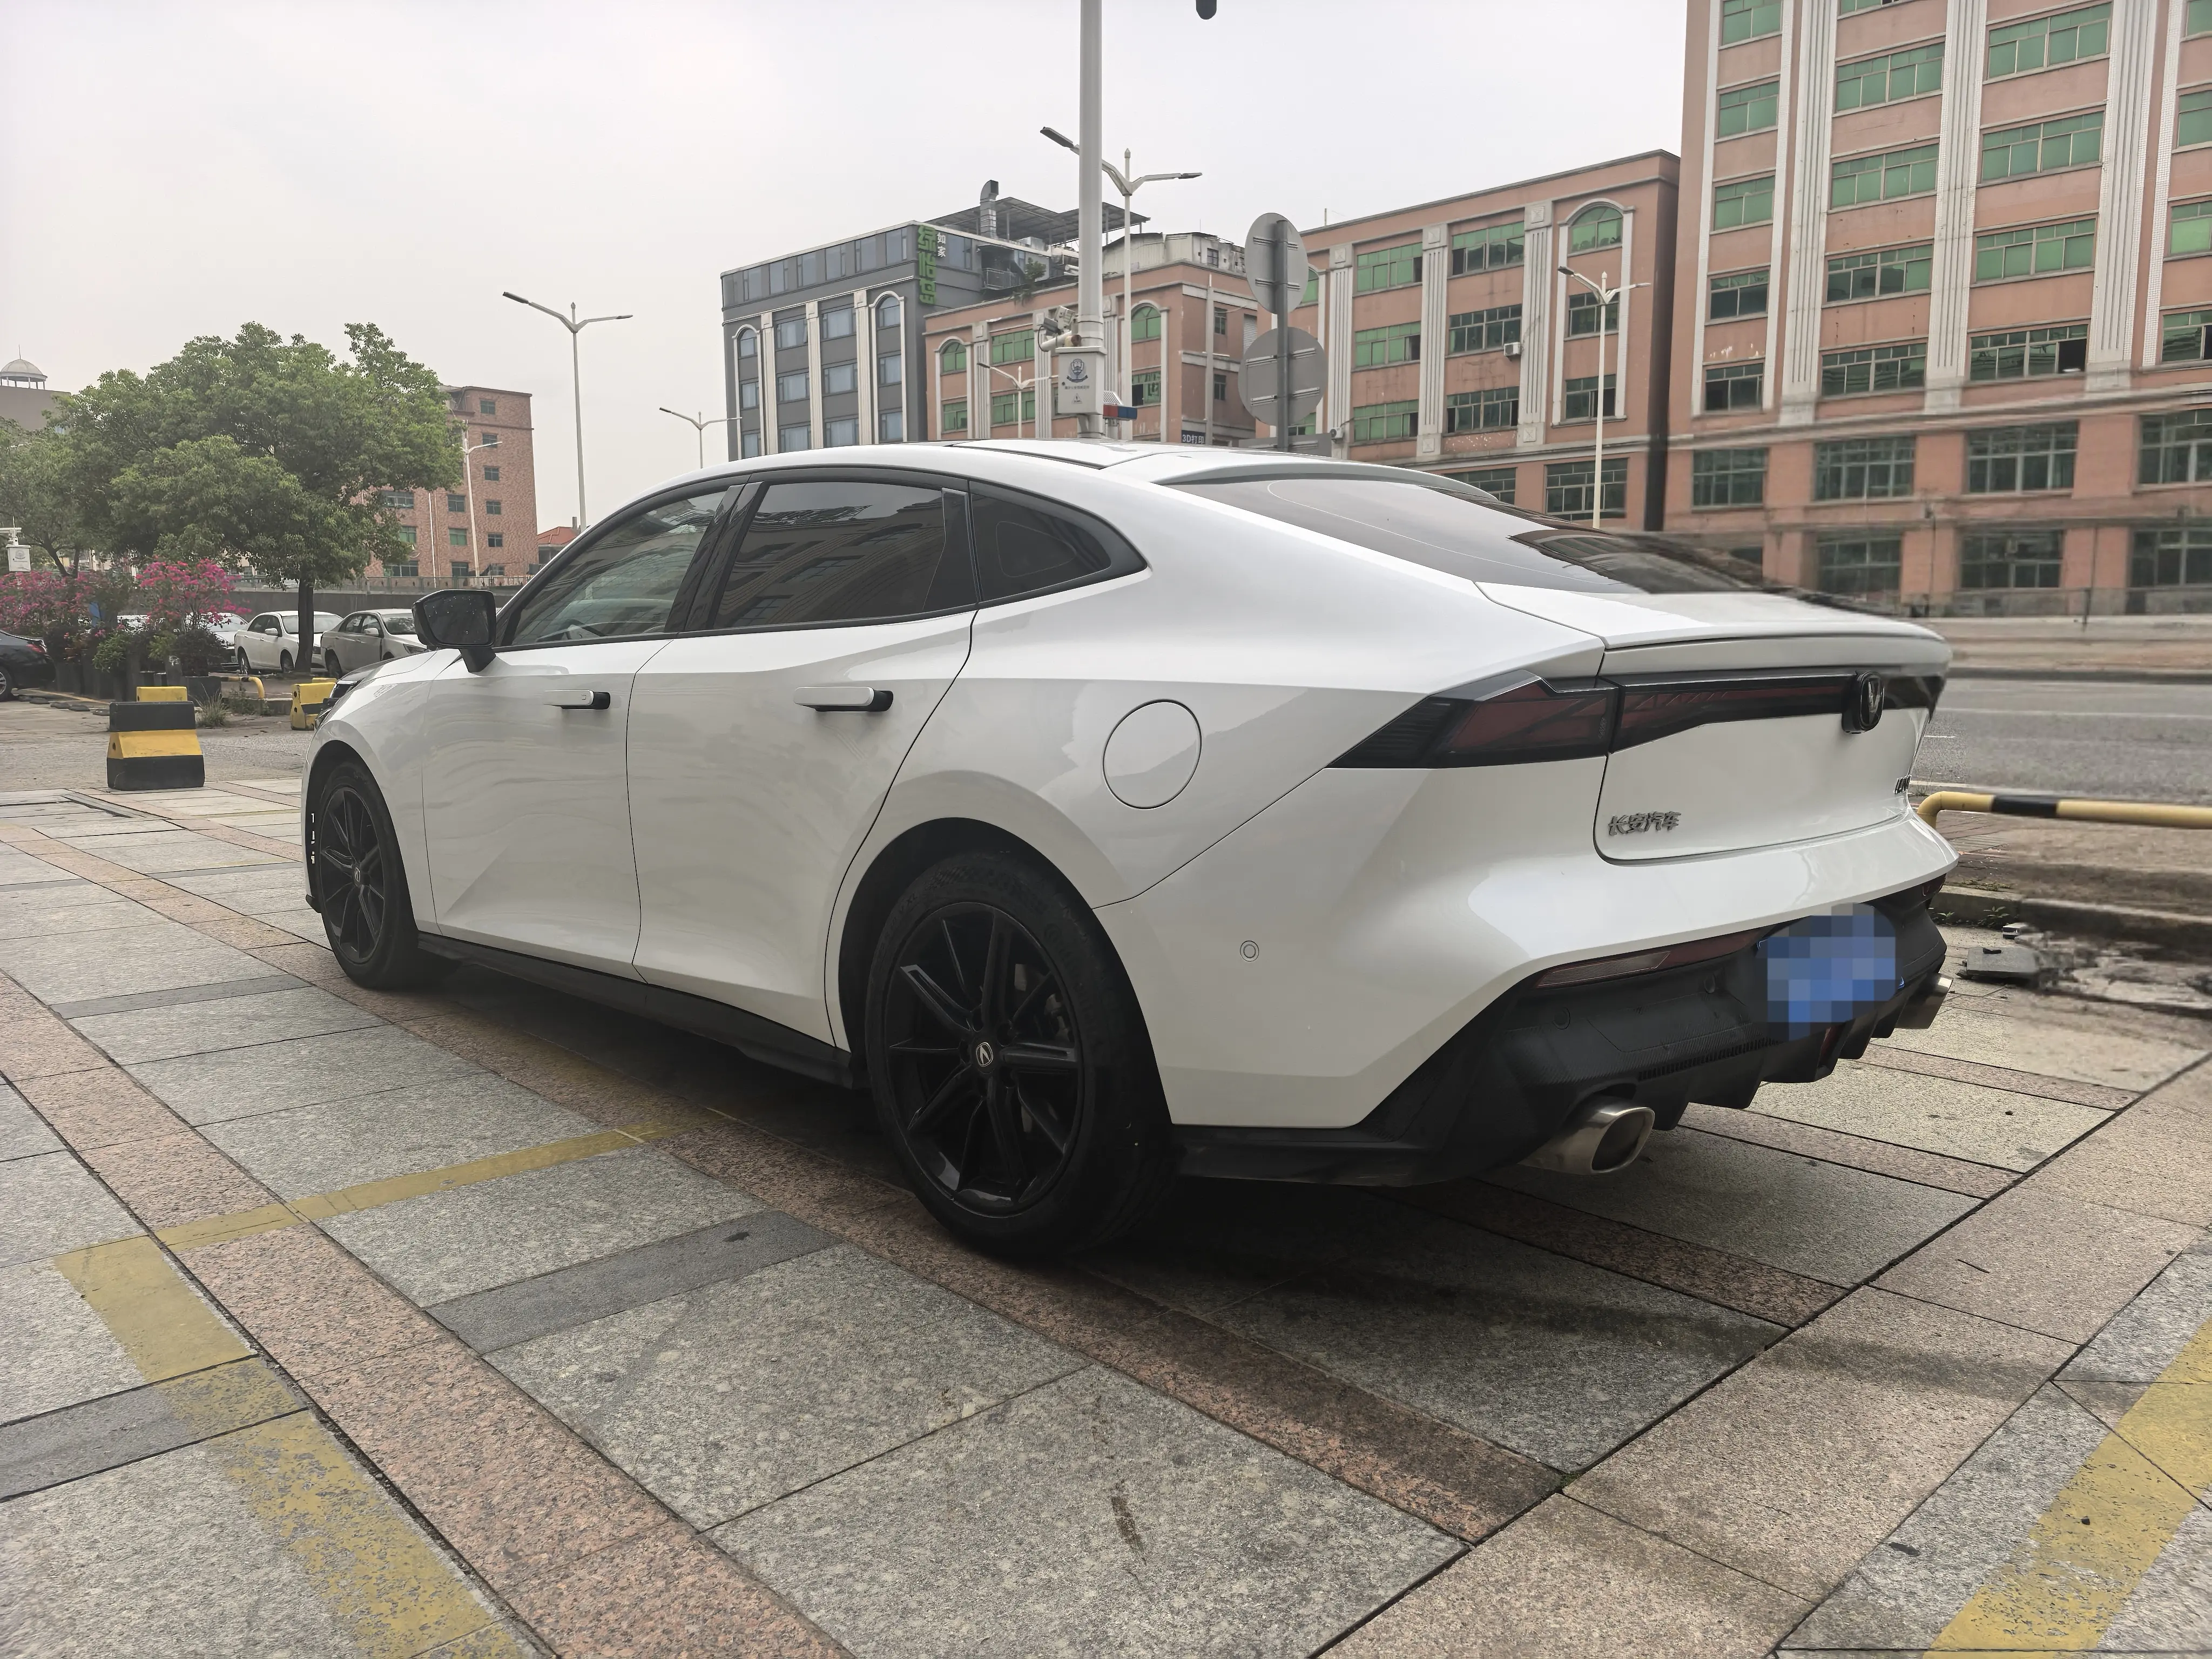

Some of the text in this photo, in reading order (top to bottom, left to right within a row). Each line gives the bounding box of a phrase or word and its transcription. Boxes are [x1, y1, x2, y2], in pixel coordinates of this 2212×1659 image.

[937, 232, 946, 257] 如家
[1182, 434, 1204, 444] 3D打印
[1608, 811, 1681, 836] 长安汽车
